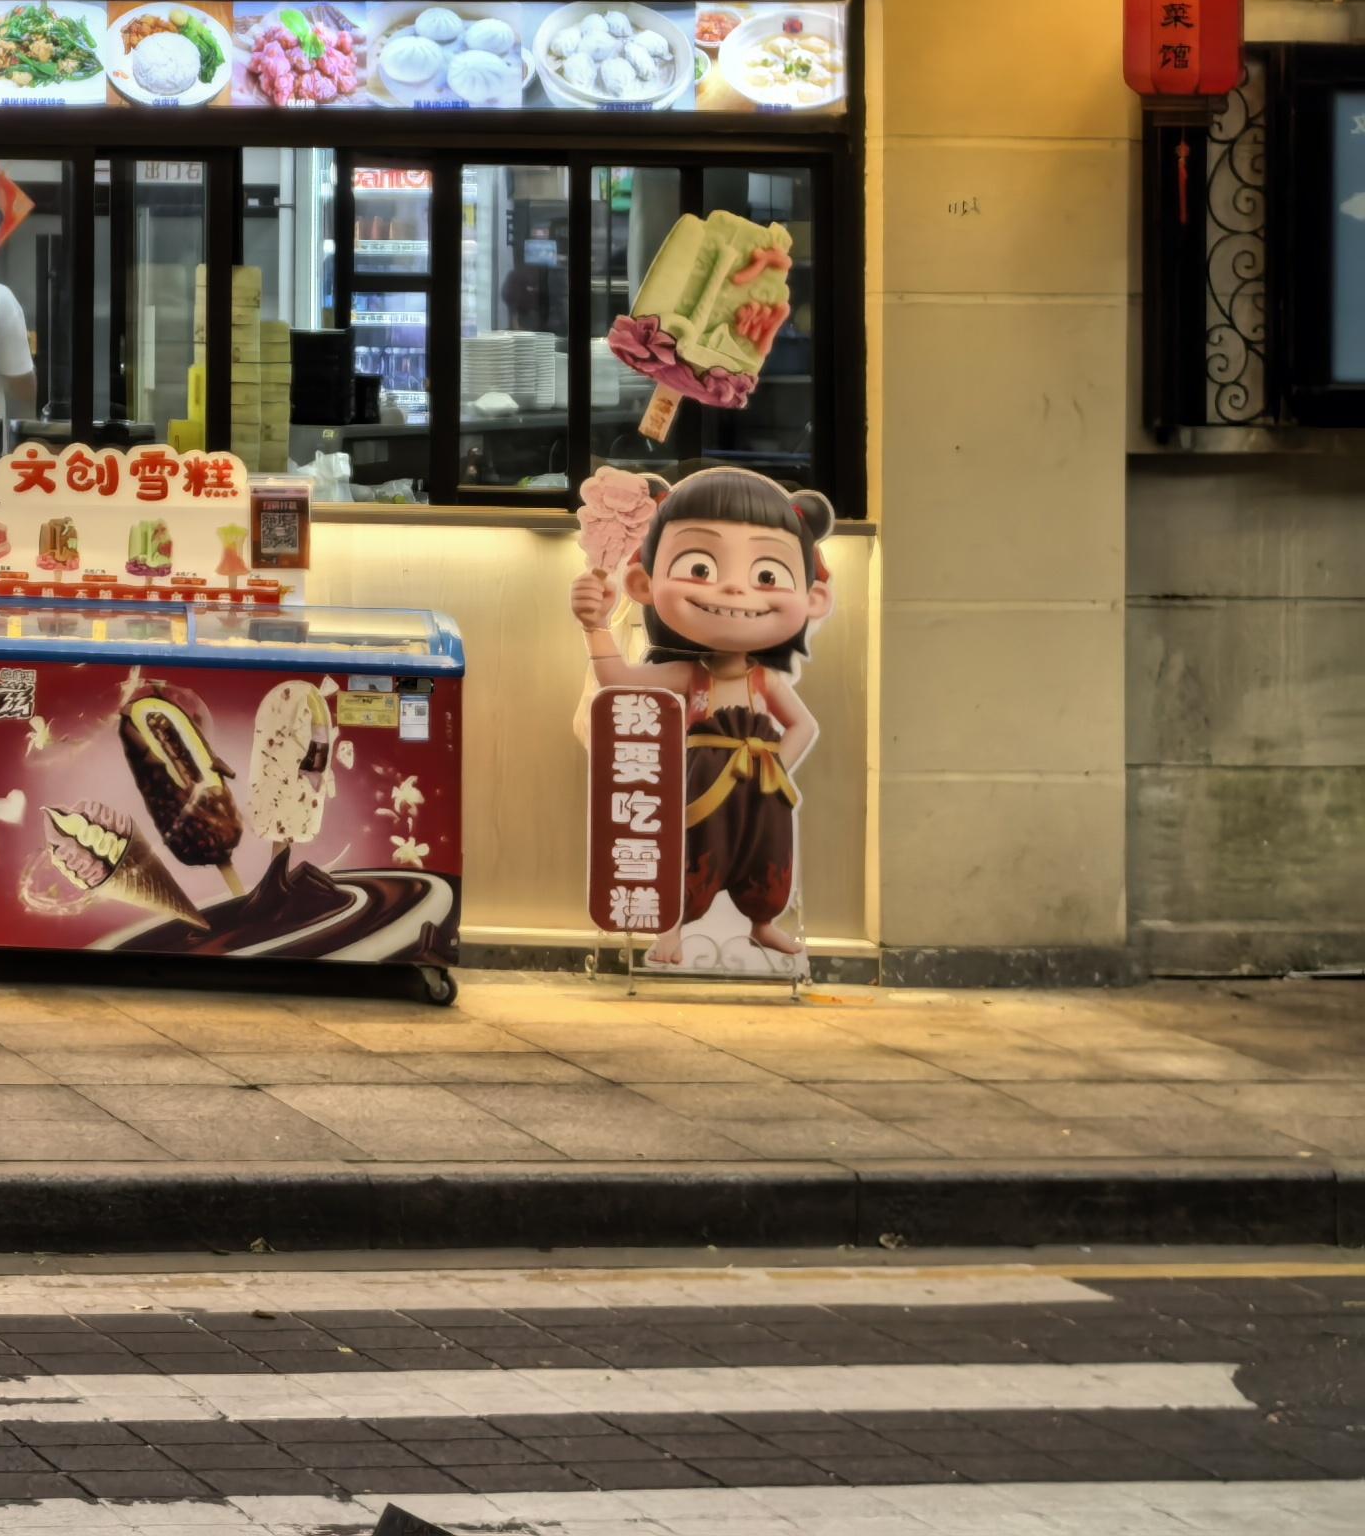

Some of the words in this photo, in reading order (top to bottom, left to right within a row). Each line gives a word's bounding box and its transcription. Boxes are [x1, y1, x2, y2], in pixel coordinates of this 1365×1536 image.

[10, 448, 239, 502] 文创雪糕
[608, 693, 664, 929] 我要吃雪糕
